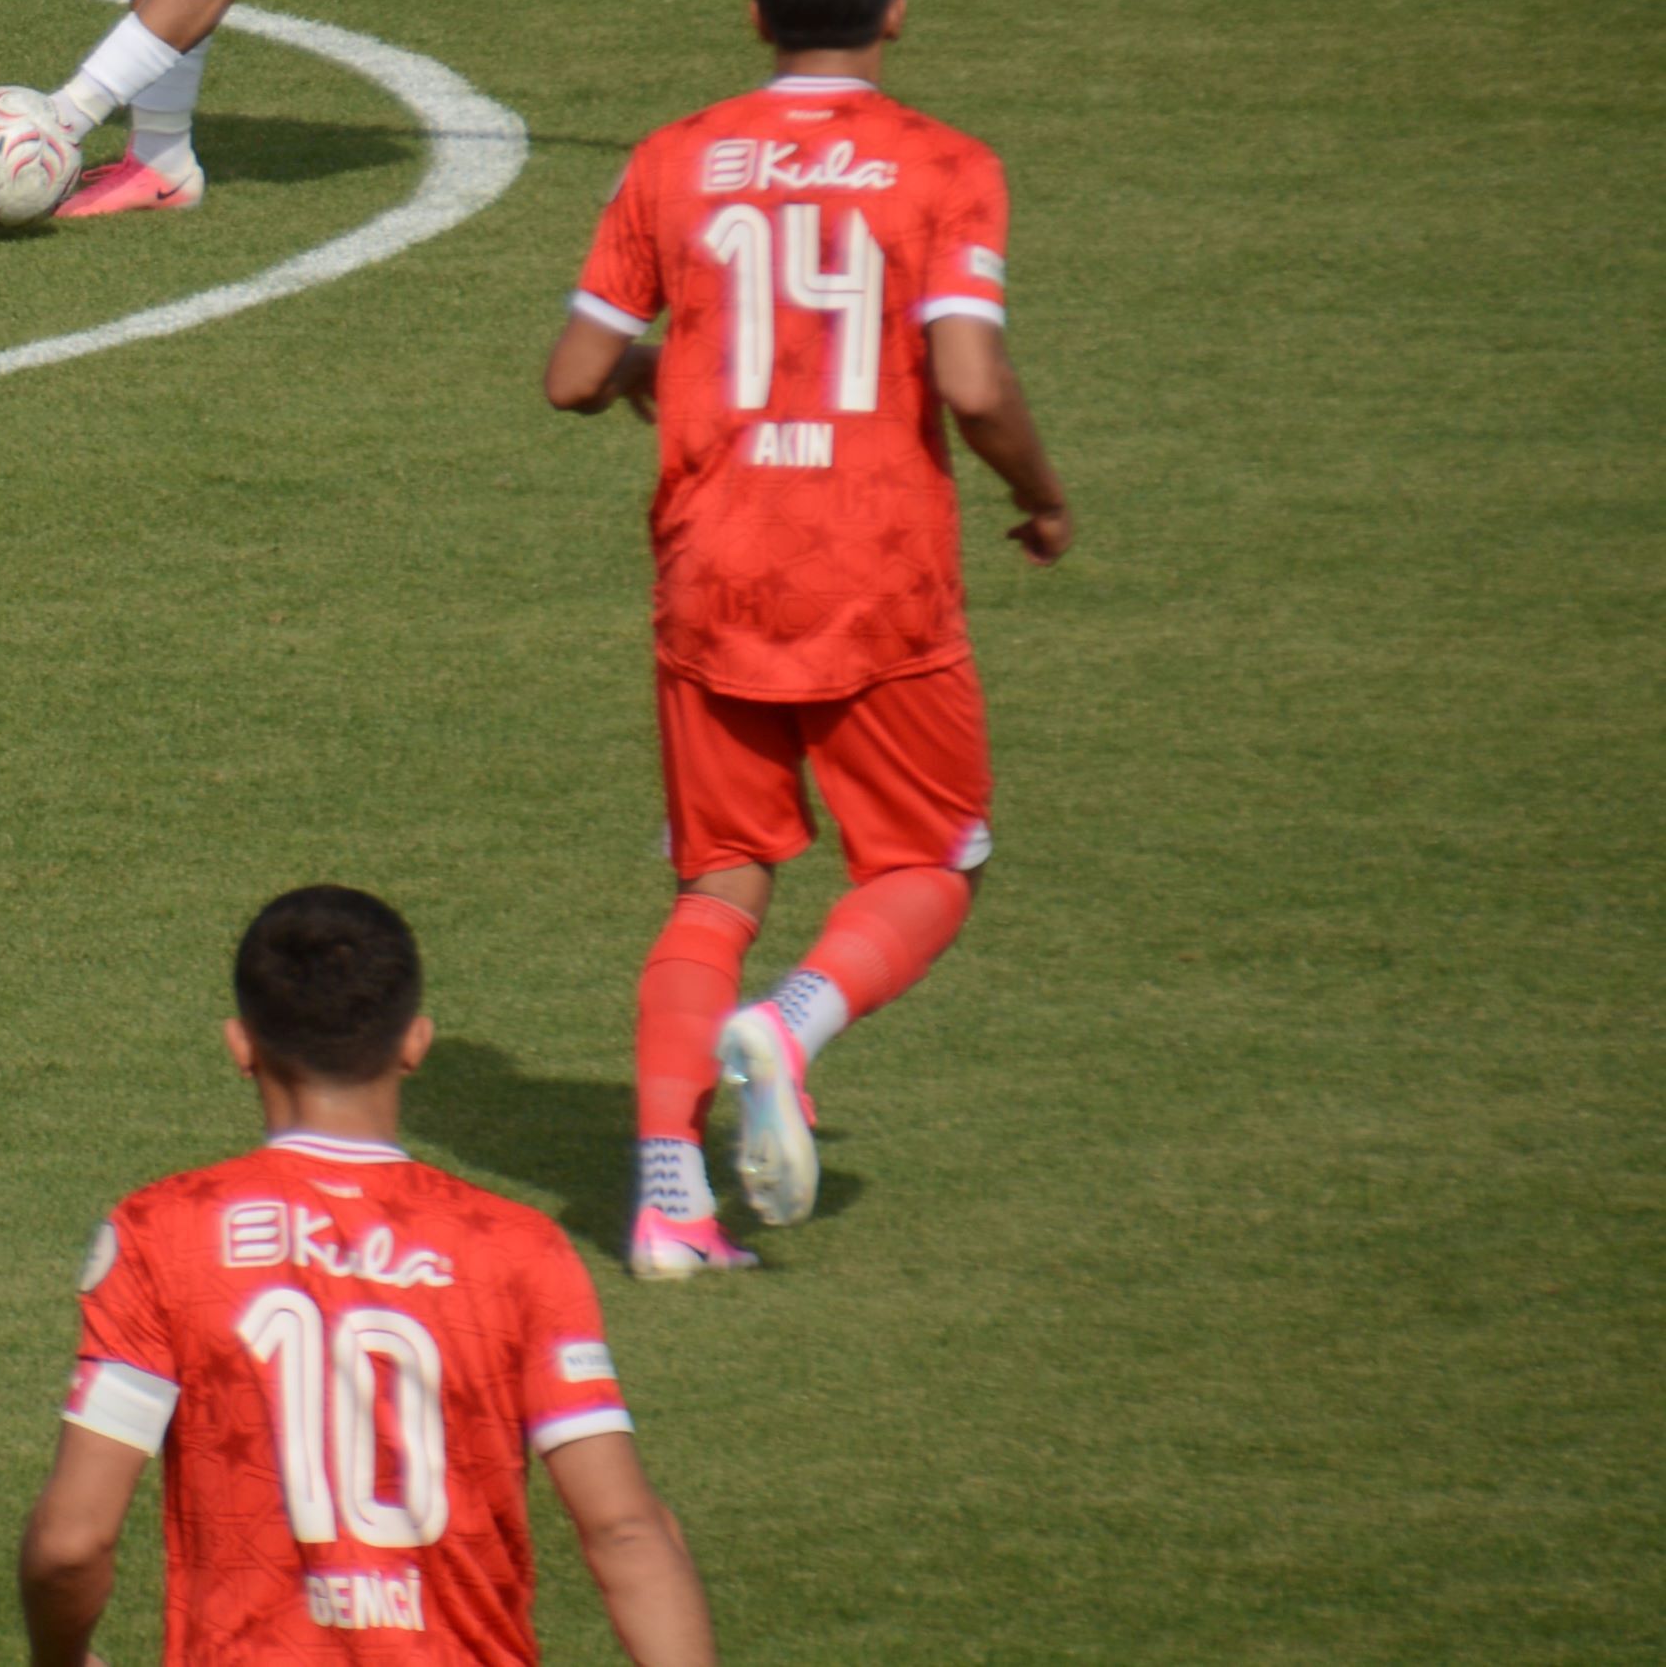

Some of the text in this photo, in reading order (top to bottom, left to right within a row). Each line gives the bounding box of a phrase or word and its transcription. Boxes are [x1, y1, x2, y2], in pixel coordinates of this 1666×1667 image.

[702, 203, 885, 412] 14
[752, 421, 835, 467] AKIN
[236, 1288, 449, 1548] 10
